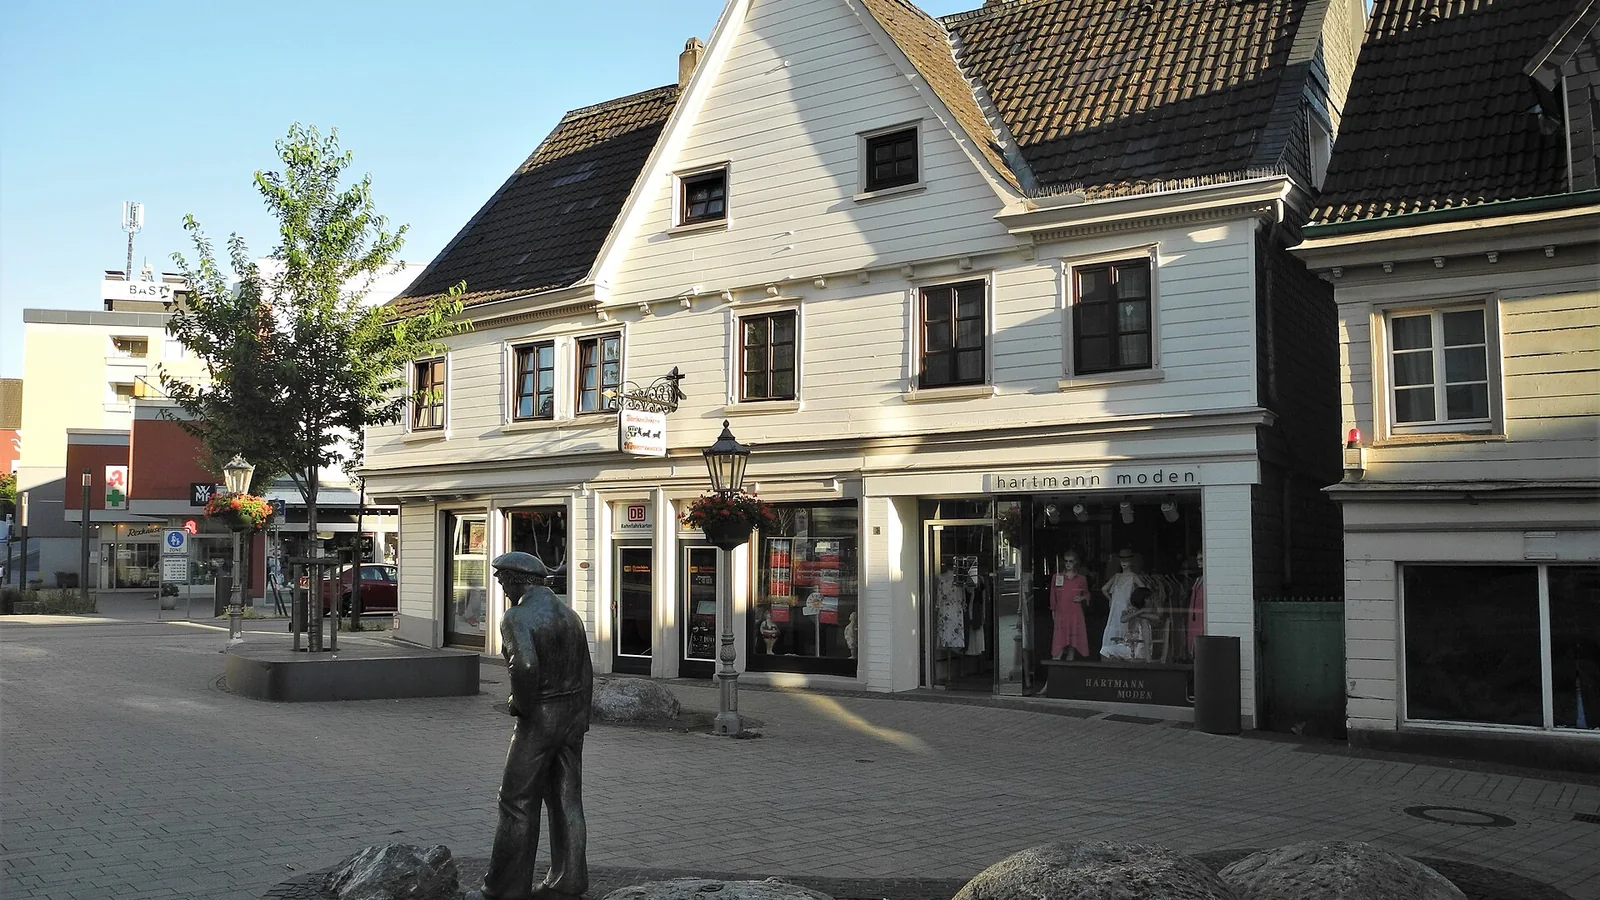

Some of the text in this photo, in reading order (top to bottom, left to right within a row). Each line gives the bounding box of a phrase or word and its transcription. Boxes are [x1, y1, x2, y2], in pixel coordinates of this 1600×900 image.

[997, 469, 1194, 489] hartmann moden
[630, 508, 644, 519] DB
[1085, 678, 1144, 689] HARTMANN
[1117, 690, 1152, 700] MODEN
